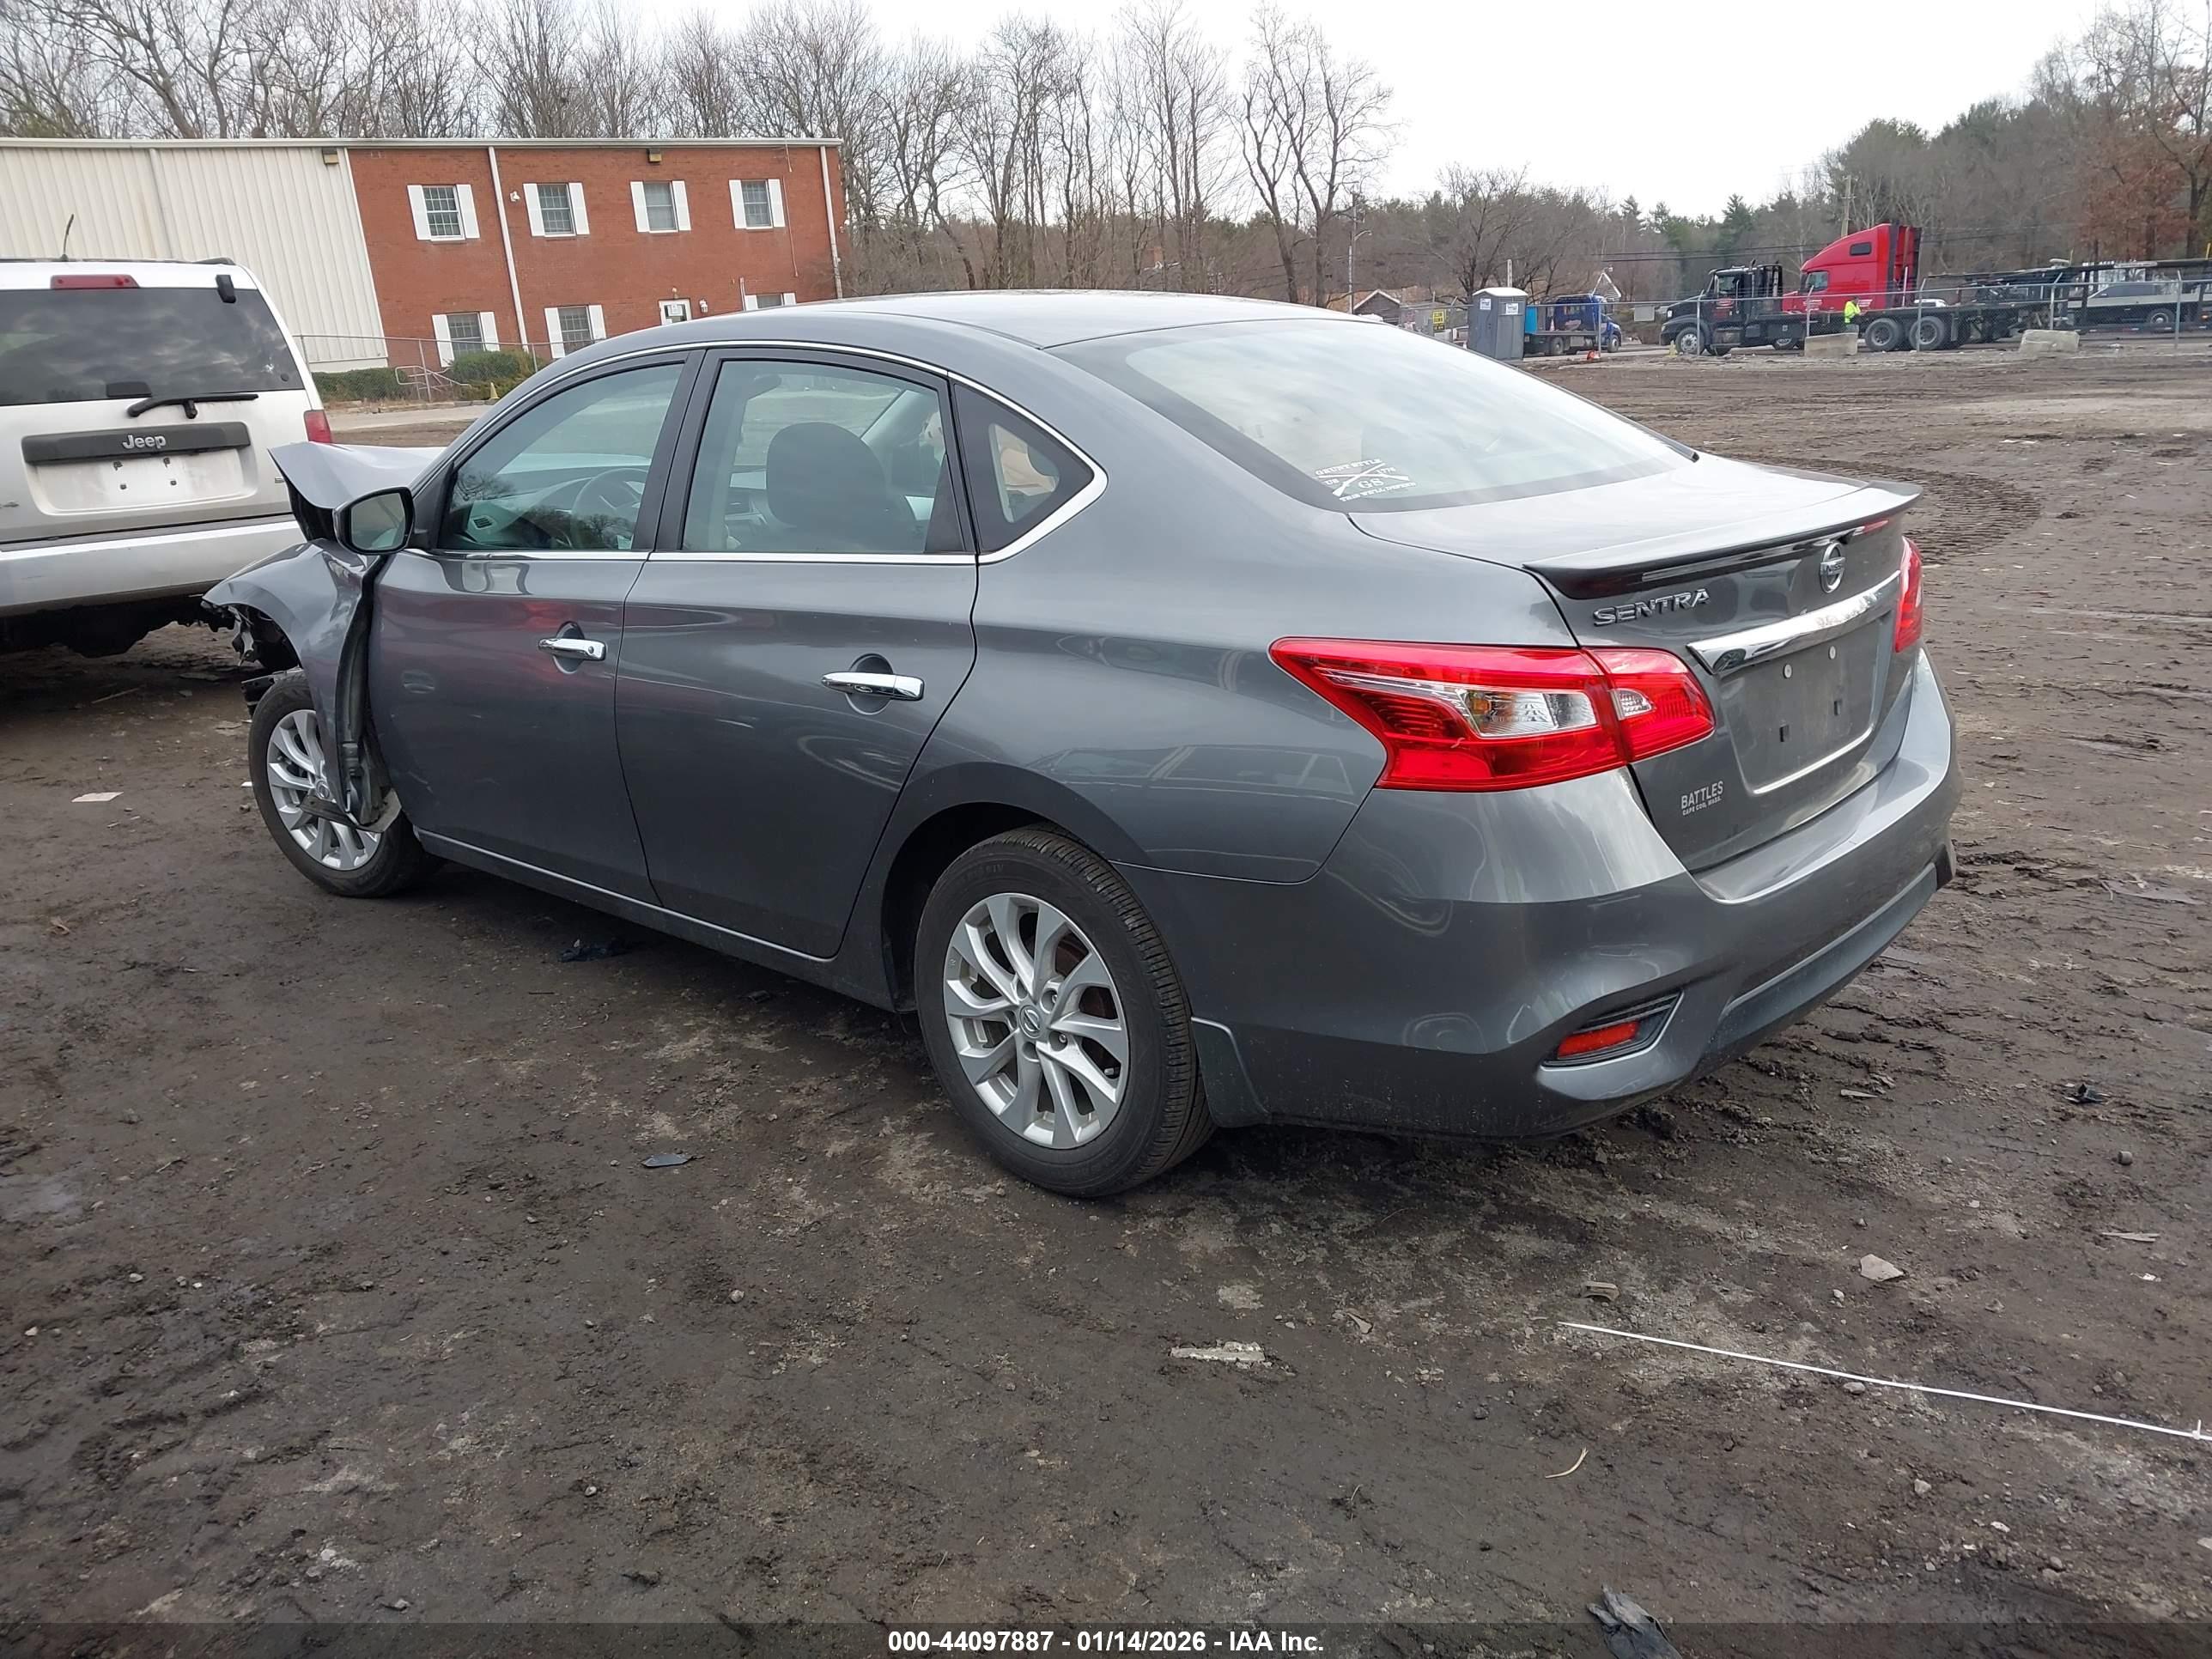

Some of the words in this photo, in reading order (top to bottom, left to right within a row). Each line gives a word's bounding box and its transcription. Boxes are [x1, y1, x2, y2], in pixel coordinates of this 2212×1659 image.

[122, 434, 167, 449] Jeep
[1315, 463, 1351, 476] GRUNT
[1358, 477, 1384, 489] GS
[1594, 588, 1711, 627] SENTRA
[1681, 780, 1723, 809] BATTLES
[1682, 805, 1695, 816] CAPE
